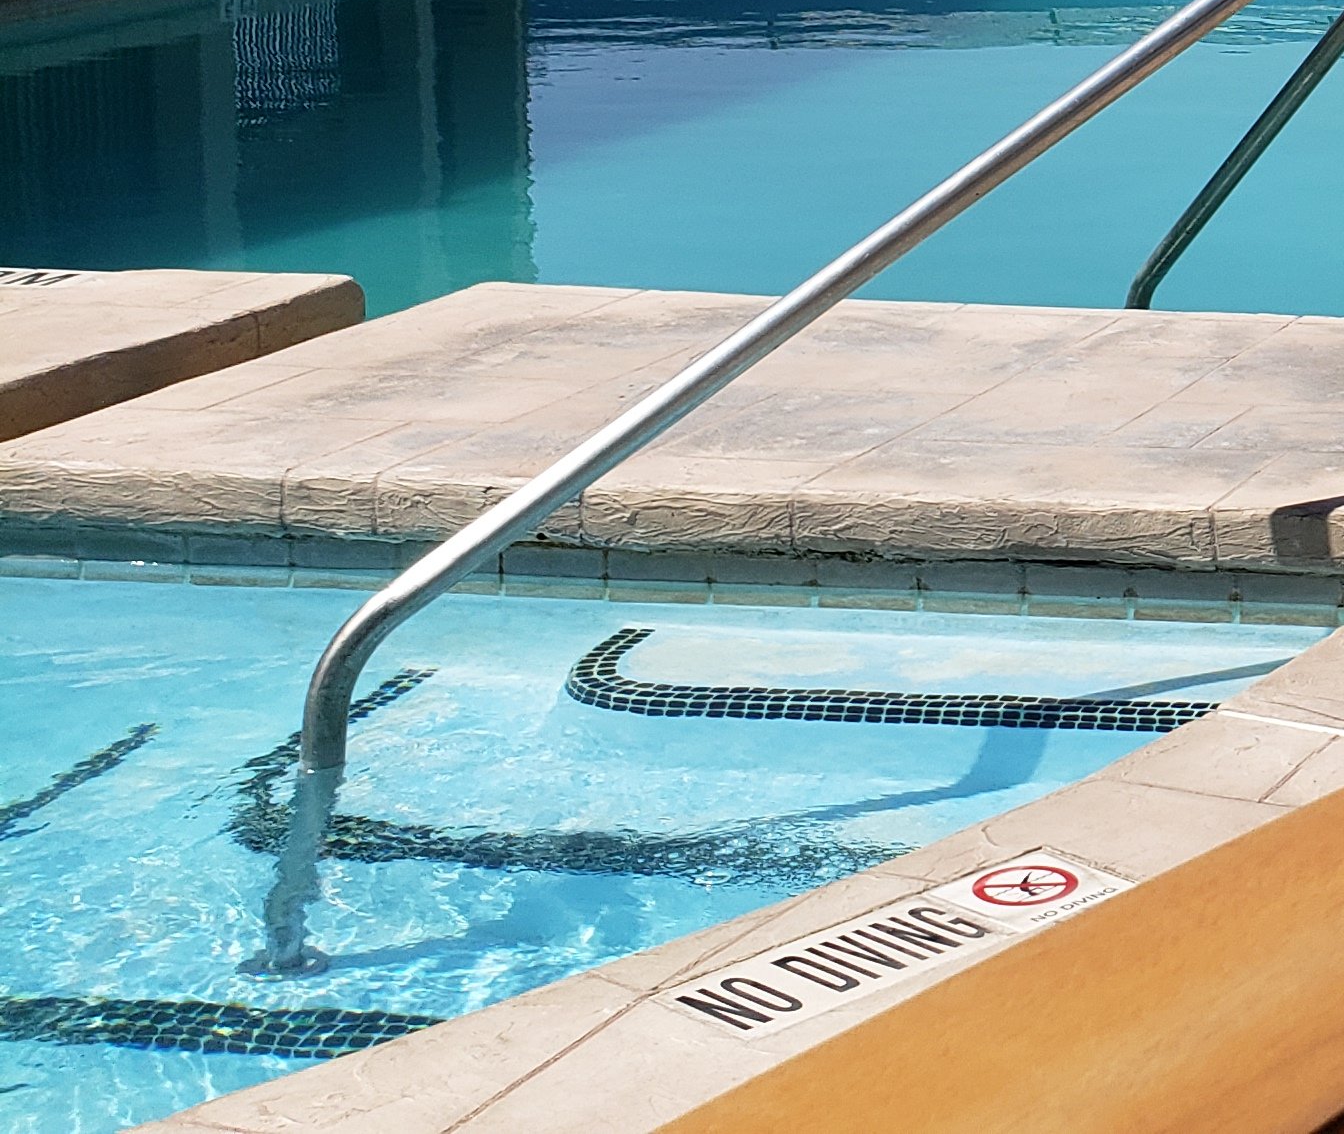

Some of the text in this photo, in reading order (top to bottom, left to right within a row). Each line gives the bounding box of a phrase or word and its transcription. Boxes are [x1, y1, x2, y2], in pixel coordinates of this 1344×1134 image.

[1030, 887, 1119, 922] NO DIVING
[675, 906, 992, 1031] NO DIVING
